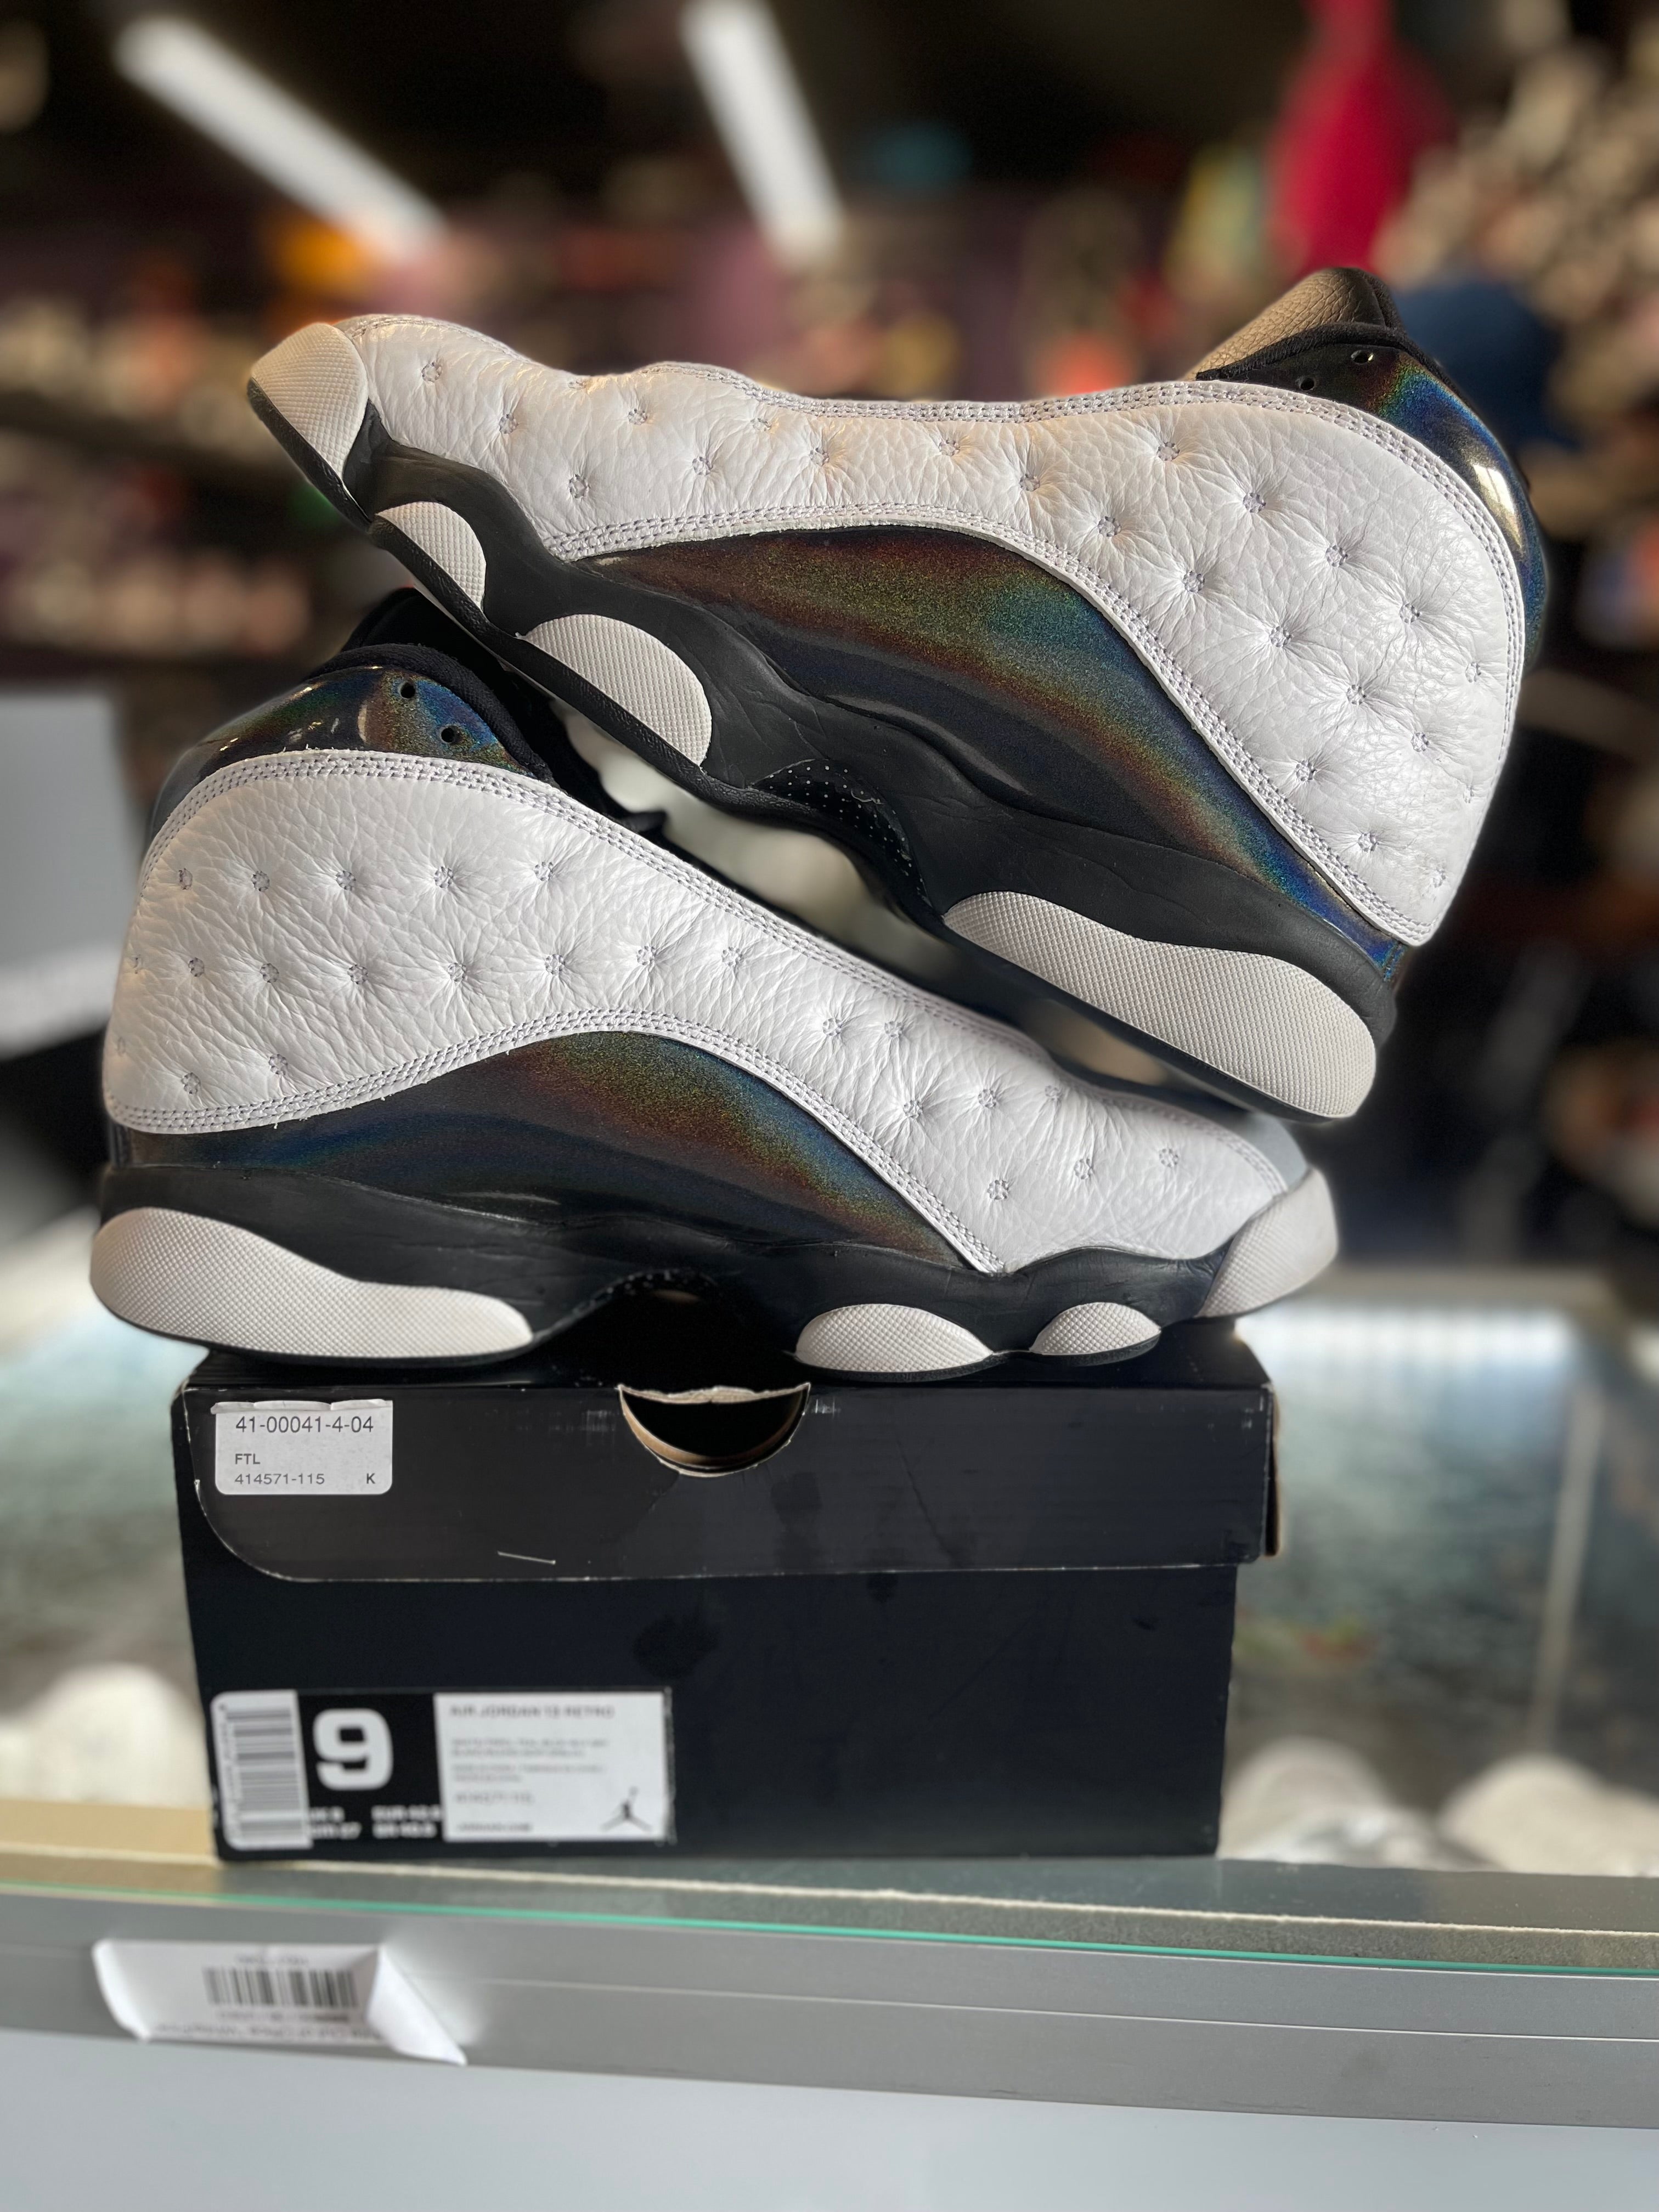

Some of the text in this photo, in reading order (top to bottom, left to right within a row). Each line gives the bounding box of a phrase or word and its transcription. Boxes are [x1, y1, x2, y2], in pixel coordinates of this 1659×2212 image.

[235, 1416, 374, 1433] 41-00041-4-04
[234, 1454, 261, 1465] FTL
[234, 1473, 376, 1485] 414571-115 K
[313, 1708, 394, 1791] 9
